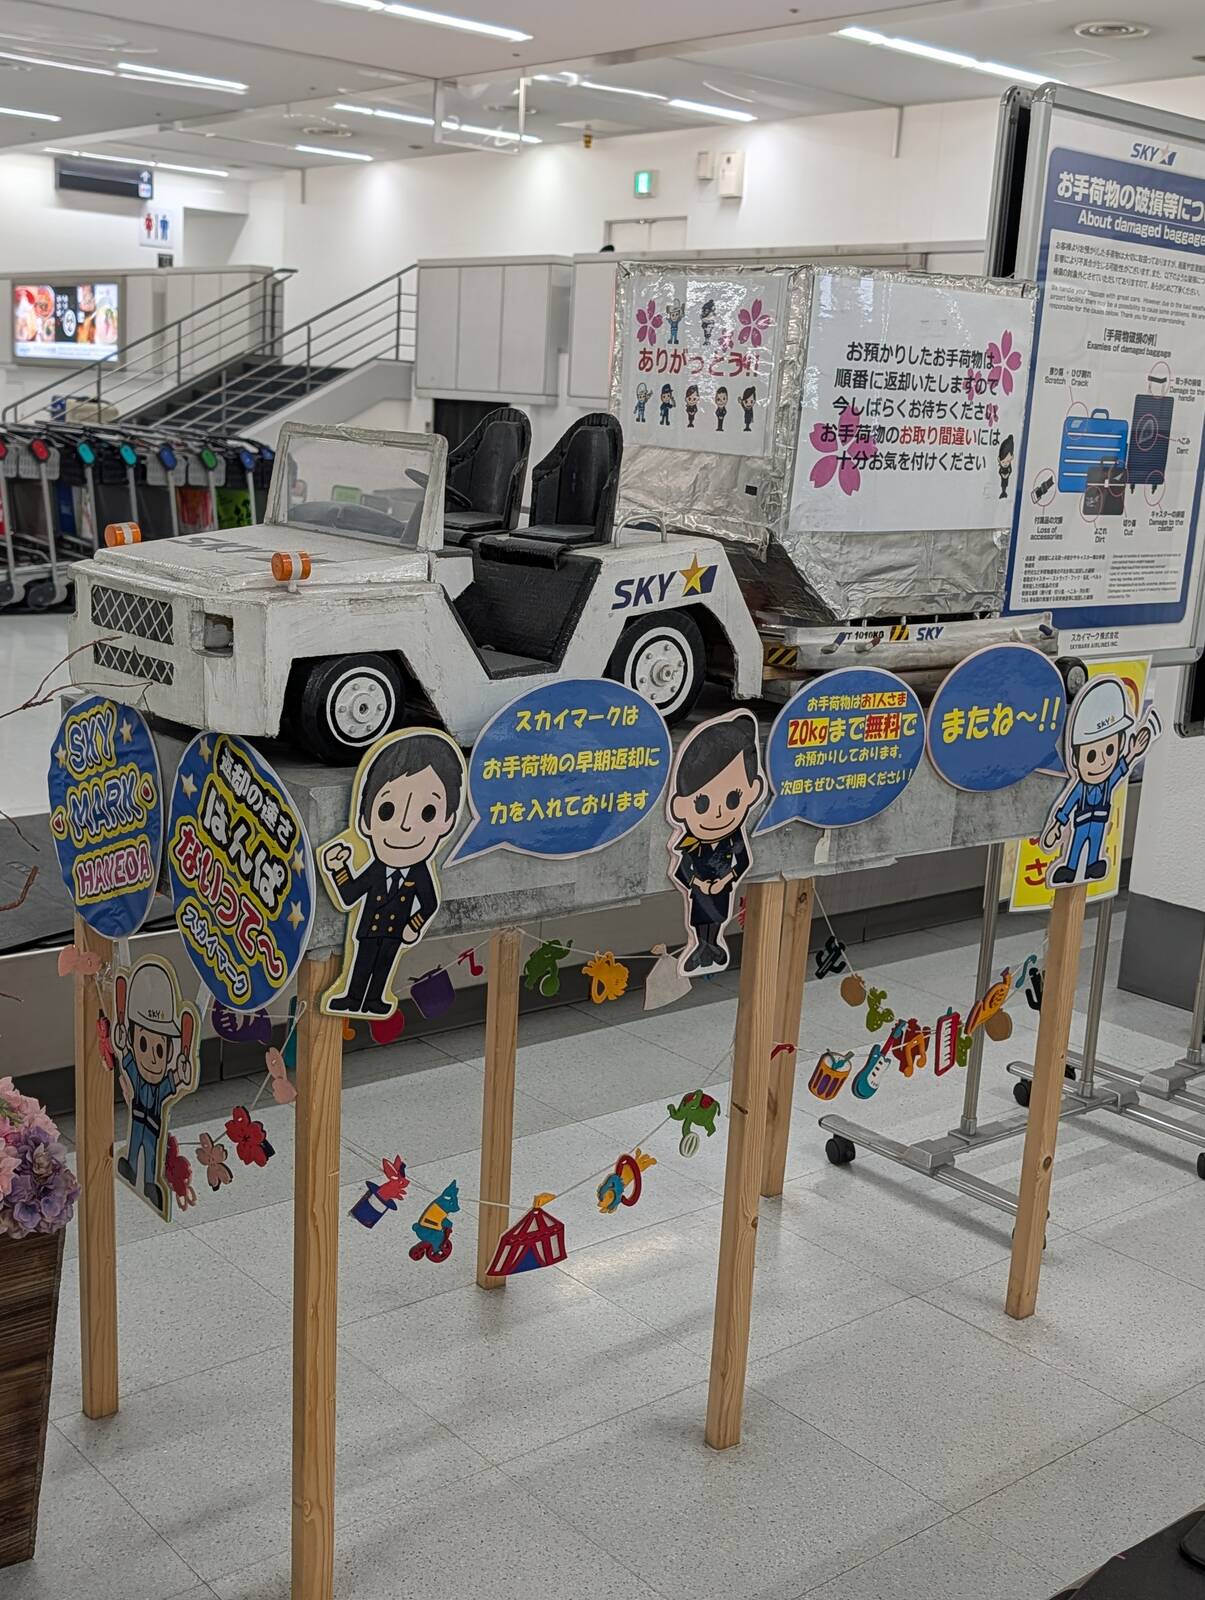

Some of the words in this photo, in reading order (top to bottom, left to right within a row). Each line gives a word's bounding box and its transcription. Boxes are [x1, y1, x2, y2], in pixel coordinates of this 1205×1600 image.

[1130, 143, 1159, 162] SKY
[1057, 171, 1205, 222] お手荷物の破損等につ
[1078, 209, 1112, 229] About
[1114, 217, 1162, 238] damaged
[846, 342, 995, 370] お預かりしたお手荷物は
[834, 368, 999, 396] 順番に返却いたしますので
[1071, 377, 1089, 387] Crack
[832, 396, 999, 421] 今しばらくお待ちください
[820, 423, 1001, 447] お手荷物のお取り間違いには
[836, 451, 987, 472] 十分お気を付けください
[611, 570, 678, 610] SKY
[916, 626, 944, 641] SKY
[807, 692, 907, 712] お手荷物はお1人さま
[515, 705, 640, 732] スカイマークは
[1096, 716, 1110, 730] SKY
[68, 707, 112, 773] SKY
[482, 747, 661, 780] お手荷物の早期返却に
[69, 770, 143, 841] MARK
[489, 790, 649, 825] 力を入れております
[203, 787, 286, 909] はんぱ
[76, 843, 153, 899] HANEDA
[182, 904, 249, 997] スカイマーク
[147, 1009, 161, 1020] SKY
